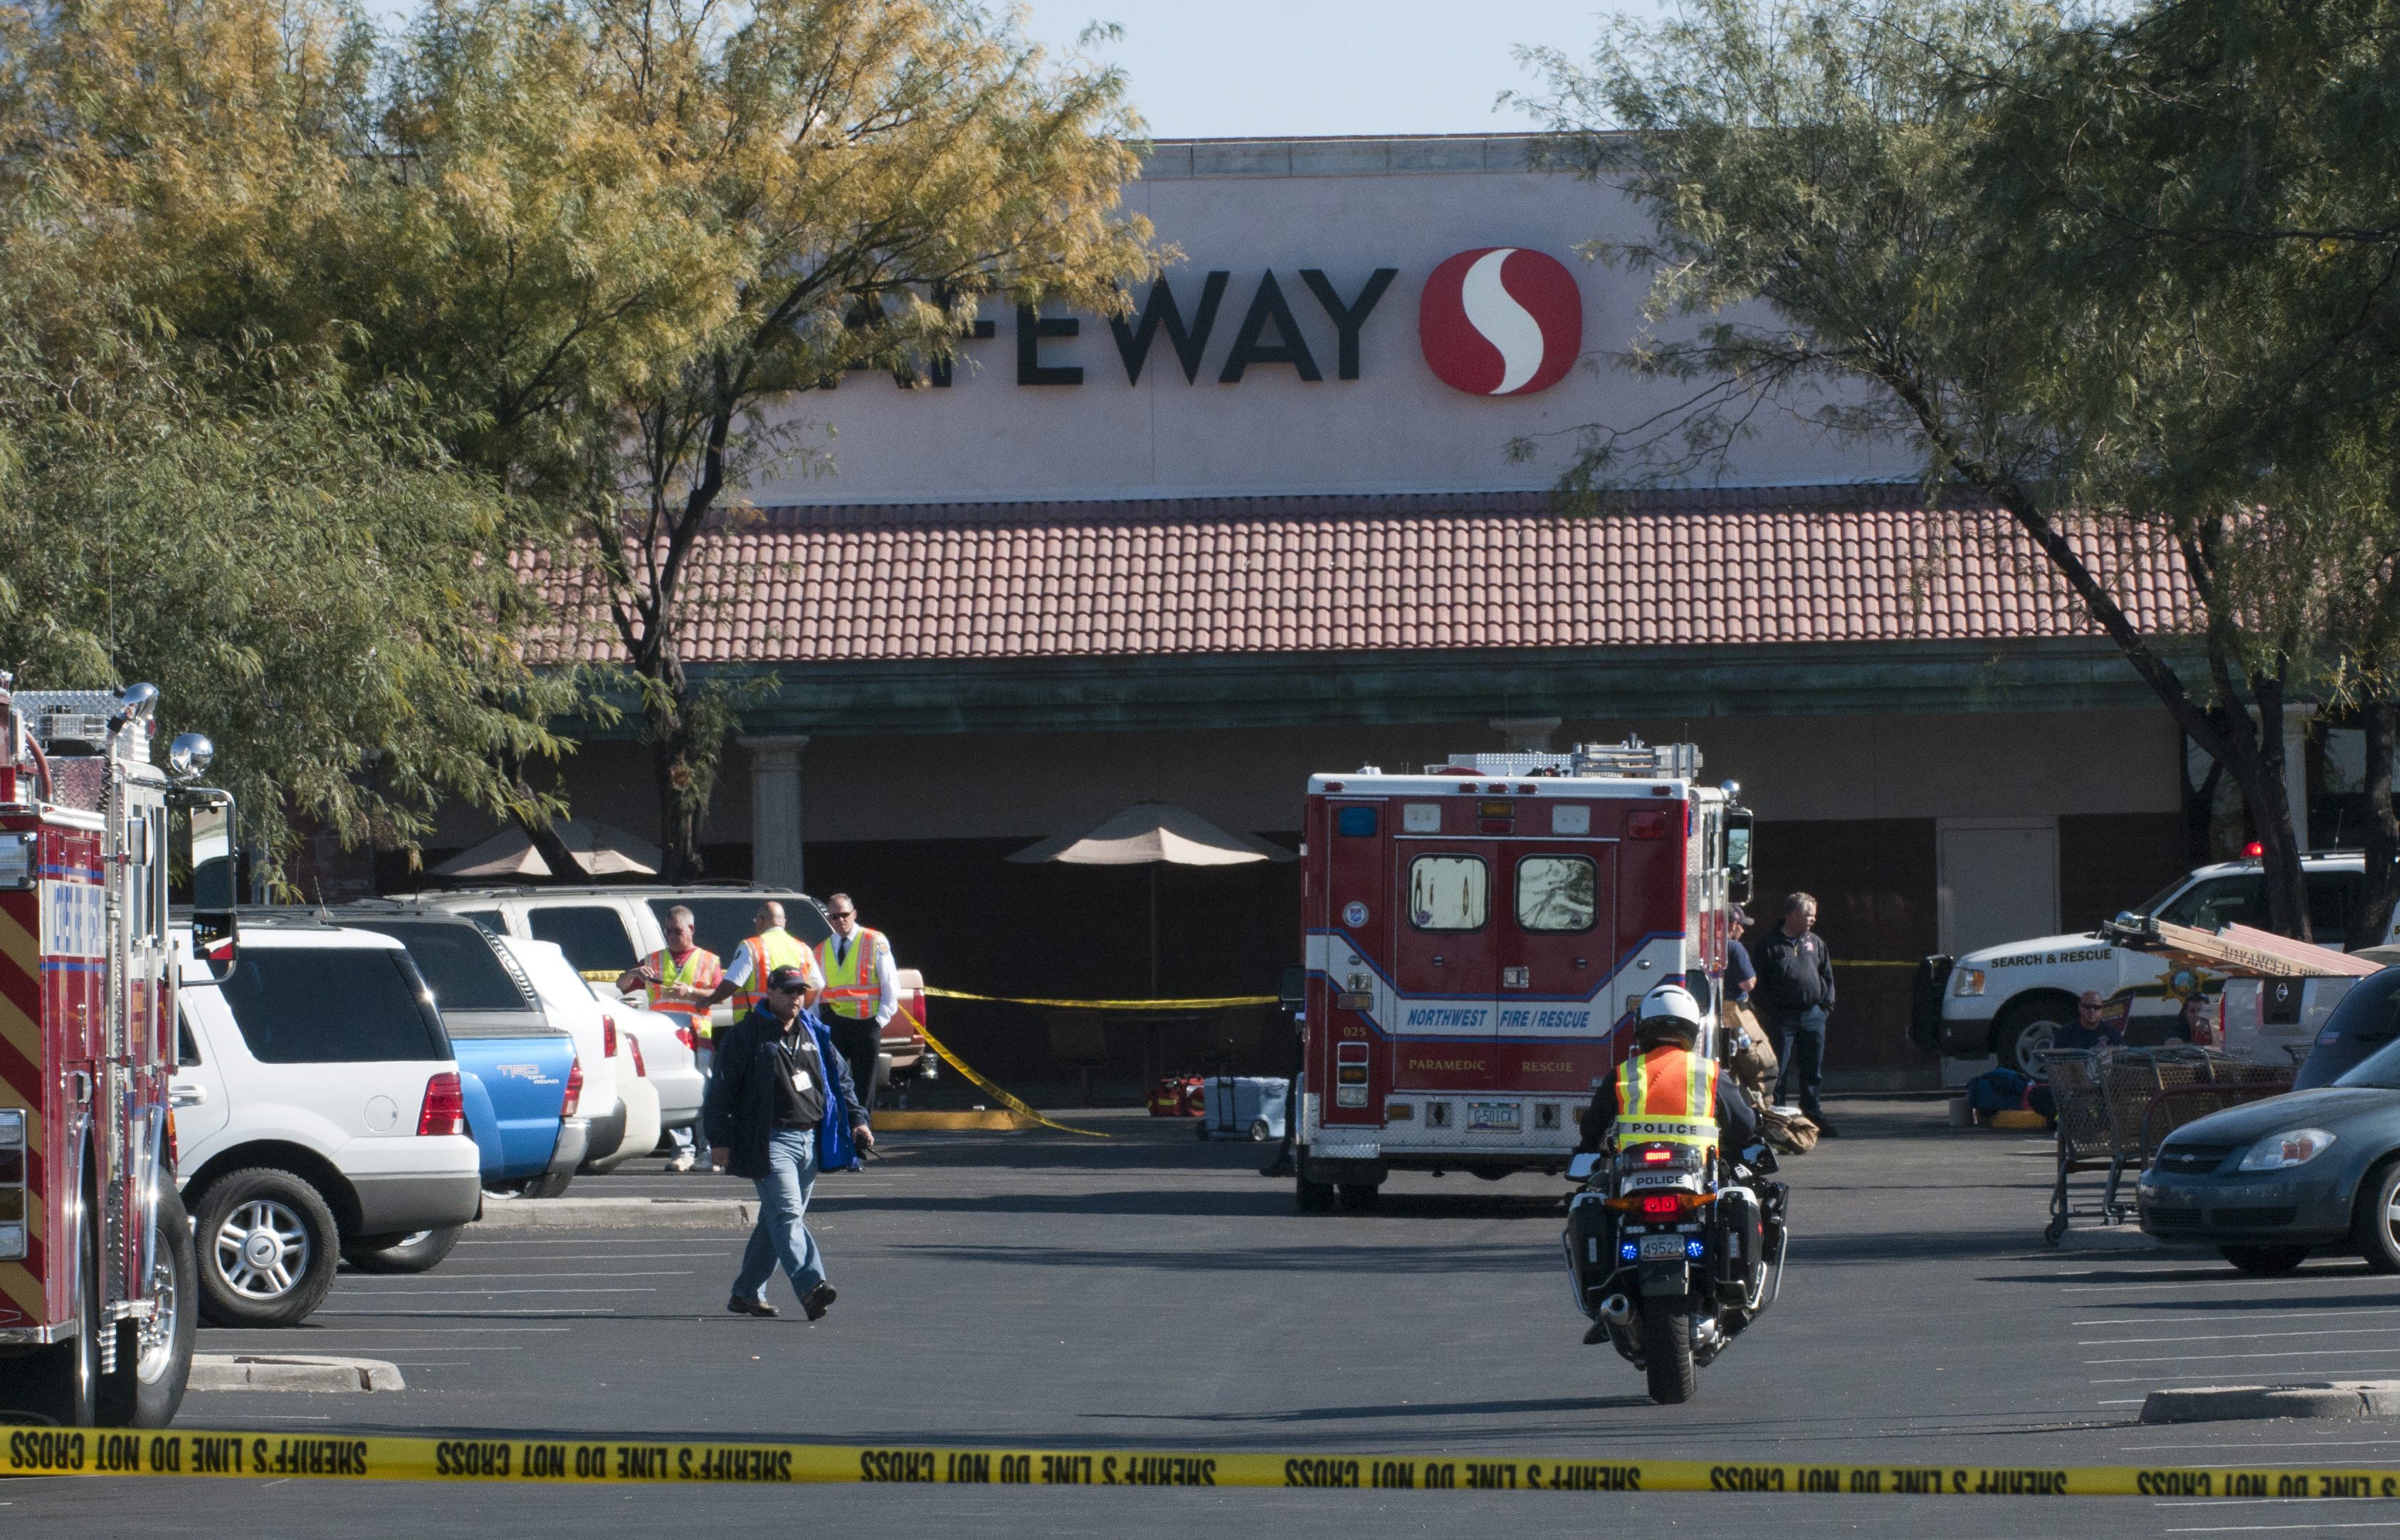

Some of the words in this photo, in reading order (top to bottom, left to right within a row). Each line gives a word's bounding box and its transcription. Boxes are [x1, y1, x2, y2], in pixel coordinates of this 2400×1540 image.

[817, 268, 1399, 389] AFEWAY
[1991, 954, 2042, 969] SEARCH
[2046, 954, 2056, 964] &
[2060, 949, 2112, 964] RESCUE
[1406, 1008, 1488, 1026] NORTHWEST
[1343, 1027, 1367, 1037] 025
[497, 1065, 539, 1078] TRD
[1409, 1060, 1486, 1071] PARAMEDIC
[1522, 1061, 1574, 1072] RESCUE
[1632, 1123, 1698, 1135] POLICE
[1636, 1175, 1683, 1186] POLICE
[10, 1431, 85, 1470] CROSS
[95, 1434, 140, 1471] NOT
[149, 1436, 181, 1472] DO
[191, 1437, 243, 1473] LINE
[253, 1438, 367, 1475] SHERIFF'S
[436, 1441, 511, 1476] CROSS
[522, 1444, 566, 1477] NOT
[574, 1445, 606, 1478] DO
[617, 1447, 668, 1479] LINE
[678, 1447, 792, 1482] SHERIFF'S
[860, 1450, 935, 1482] CROSS
[947, 1453, 990, 1482] NOT
[1000, 1455, 1031, 1483] DO
[1042, 1455, 1092, 1484] LINE
[1284, 1457, 1359, 1487] CROSS
[1372, 1461, 1414, 1487] NOT
[1426, 1462, 1455, 1488] DO
[1465, 1463, 1517, 1488] LINE
[1527, 1464, 1641, 1490] SHERIFFS
[1952, 1470, 2068, 1494] SHERIFFS
